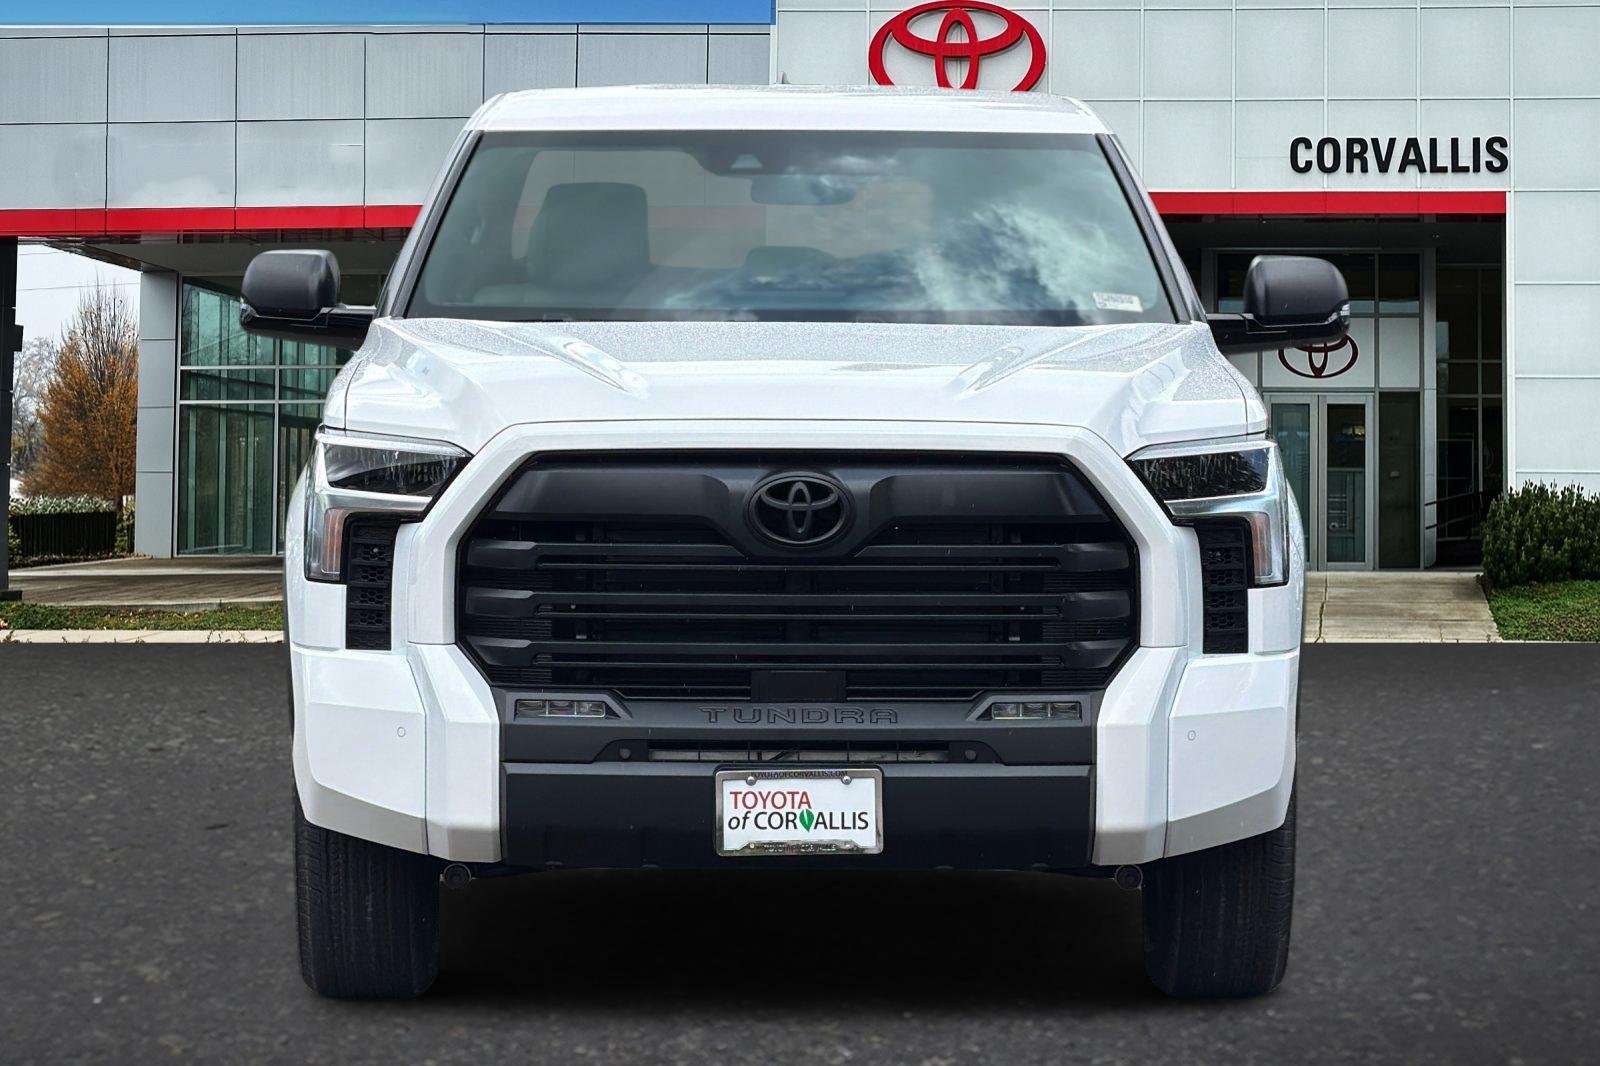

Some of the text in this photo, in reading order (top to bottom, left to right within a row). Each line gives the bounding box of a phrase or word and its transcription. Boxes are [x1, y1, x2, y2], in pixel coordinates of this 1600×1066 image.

[1290, 136, 1509, 174] CORVALLIS
[699, 707, 898, 724] TUNDRA
[729, 790, 812, 810] TOYOTA
[728, 811, 751, 830] of
